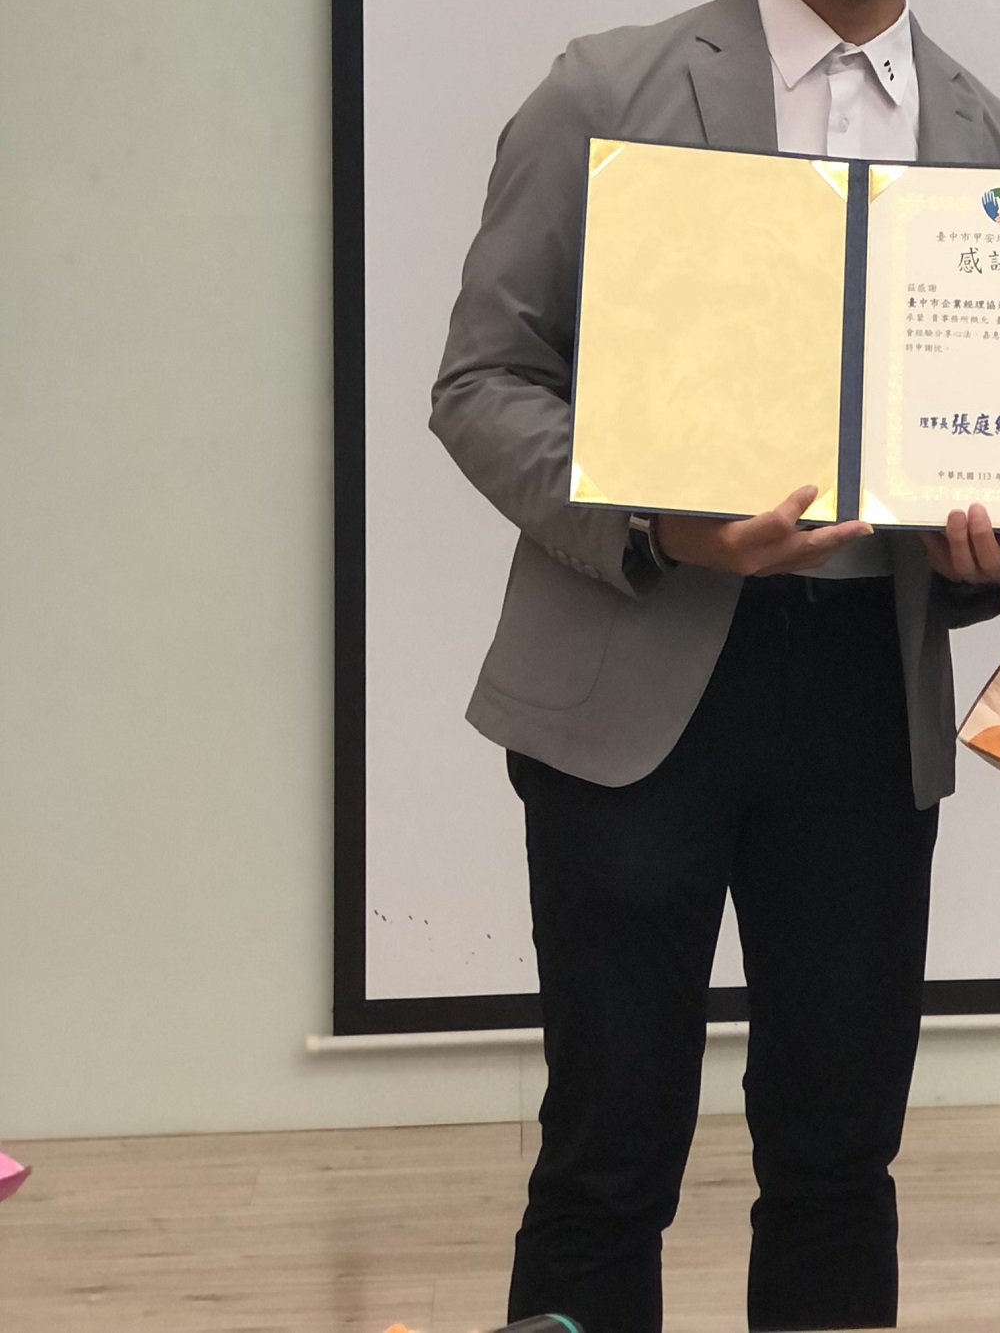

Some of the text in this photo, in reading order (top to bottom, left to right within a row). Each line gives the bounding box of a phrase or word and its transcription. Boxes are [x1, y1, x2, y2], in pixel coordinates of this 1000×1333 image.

[919, 416, 949, 430] 理事長
[937, 470, 975, 481] 中華民國
